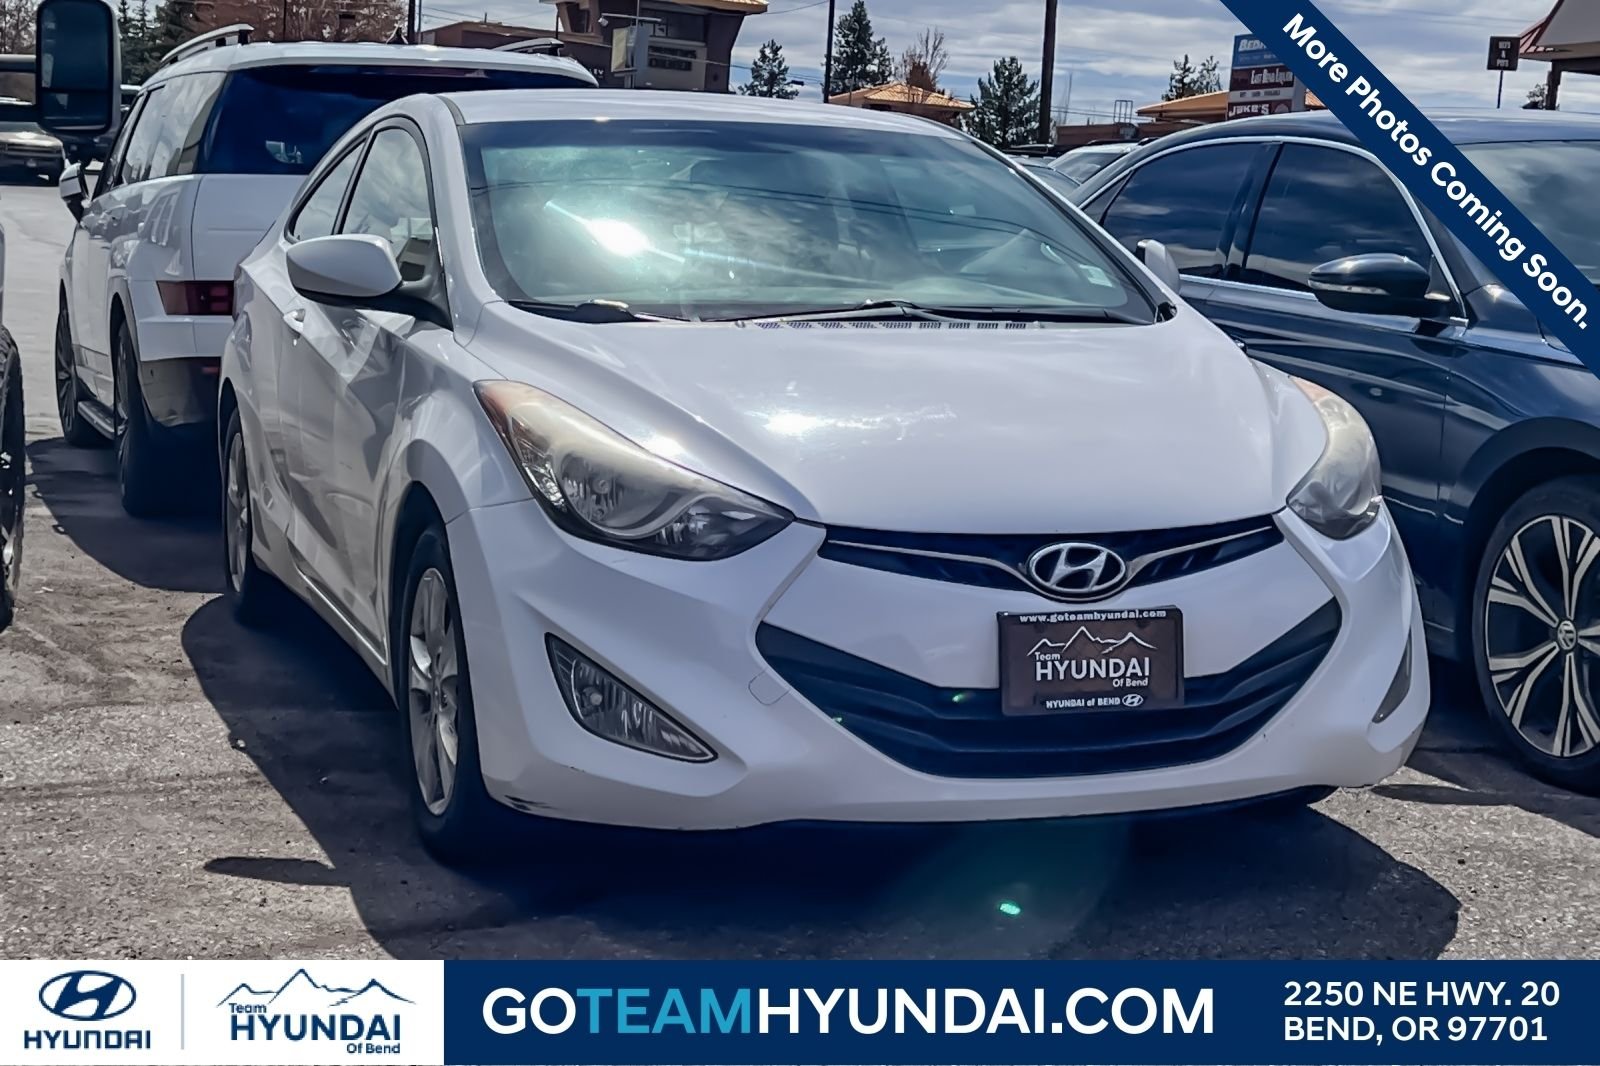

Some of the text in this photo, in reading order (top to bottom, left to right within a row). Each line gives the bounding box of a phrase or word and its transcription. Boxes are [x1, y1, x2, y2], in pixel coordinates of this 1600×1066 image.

[1020, 610, 1166, 622] www.goteamhyundai.com
[1035, 652, 1061, 661] Team
[1036, 657, 1149, 680] HYUNDAI
[1112, 678, 1149, 688] Of Bend
[1046, 699, 1085, 709] HYUNDAI
[1098, 697, 1121, 706] BEND
